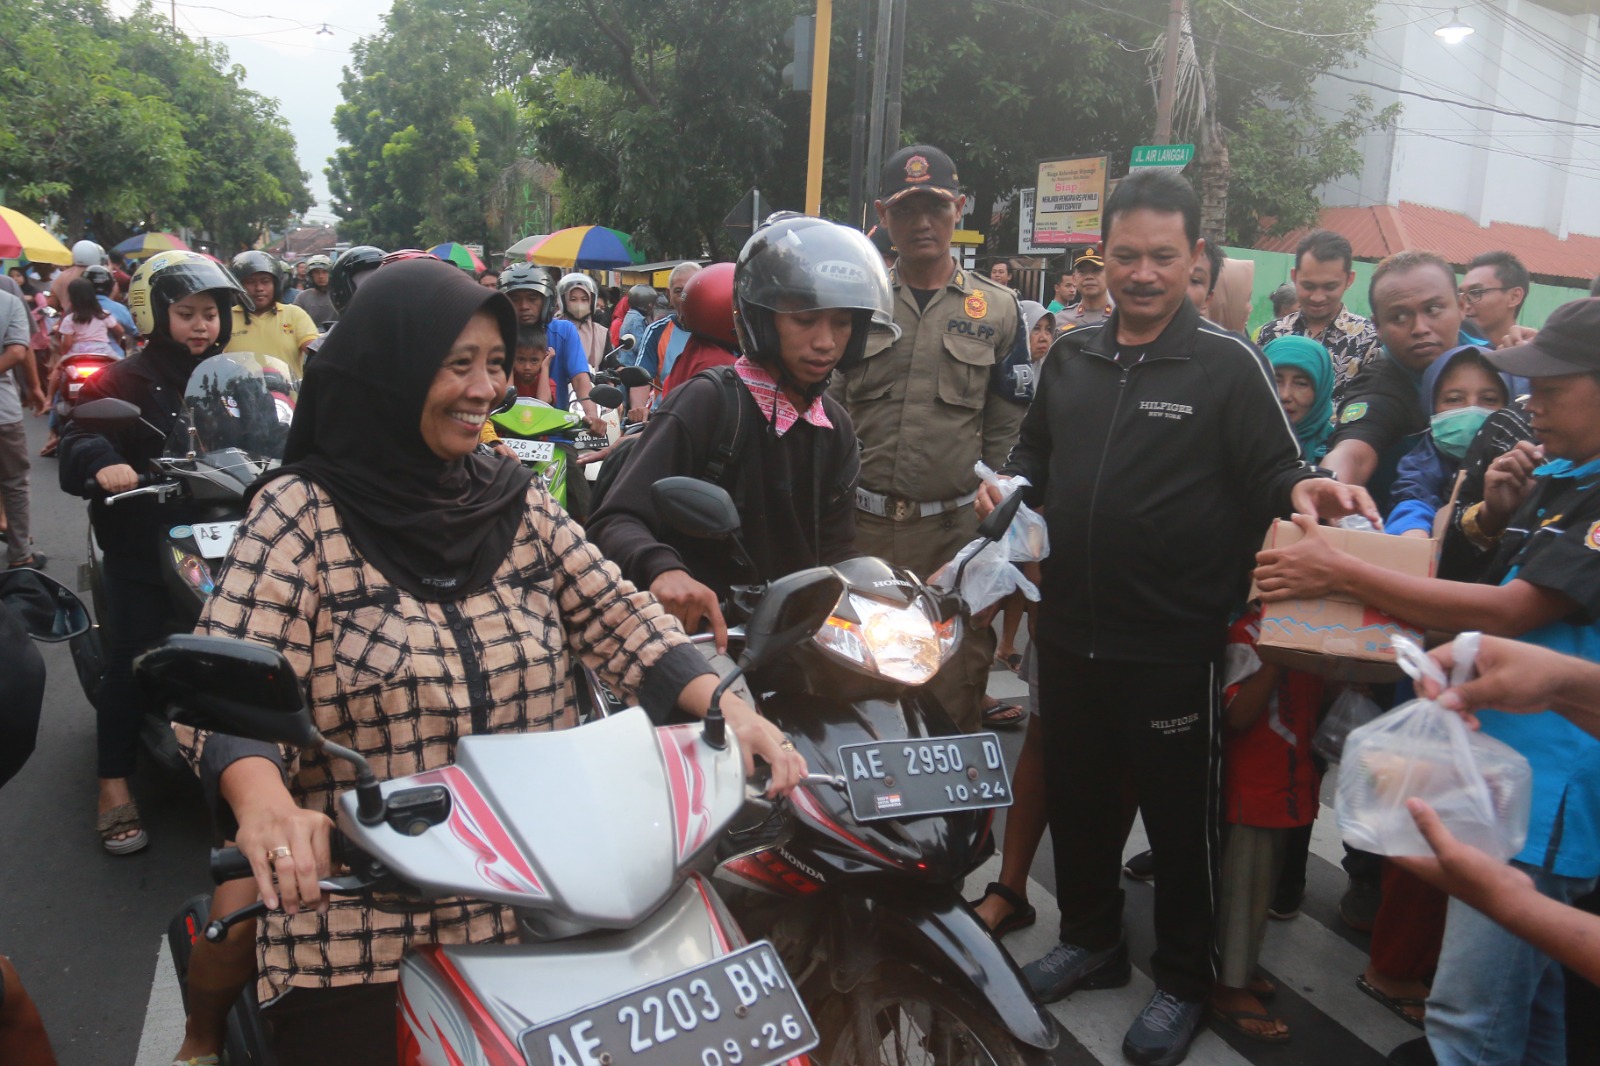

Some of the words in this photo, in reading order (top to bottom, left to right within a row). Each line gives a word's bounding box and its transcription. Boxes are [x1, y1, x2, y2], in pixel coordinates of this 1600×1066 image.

[1145, 150, 1157, 161] AIR
[1158, 149, 1185, 161] LANGGA
[1055, 183, 1077, 193] Siap
[820, 264, 864, 280] INK
[948, 319, 976, 336] POL
[976, 324, 995, 340] PP
[1139, 401, 1194, 415] HILFIGER
[1164, 412, 1182, 420] YORK
[536, 442, 552, 452] XZ
[200, 525, 222, 540] AE
[872, 580, 913, 588] HONDA
[1150, 712, 1199, 729] HILFIGER
[851, 748, 885, 781] AE
[902, 744, 963, 776] 2950
[981, 740, 1000, 770] D
[780, 847, 826, 883] HONDA
[548, 1019, 601, 1066] AE
[617, 978, 721, 1053] 2203
[724, 951, 785, 1007] BM
